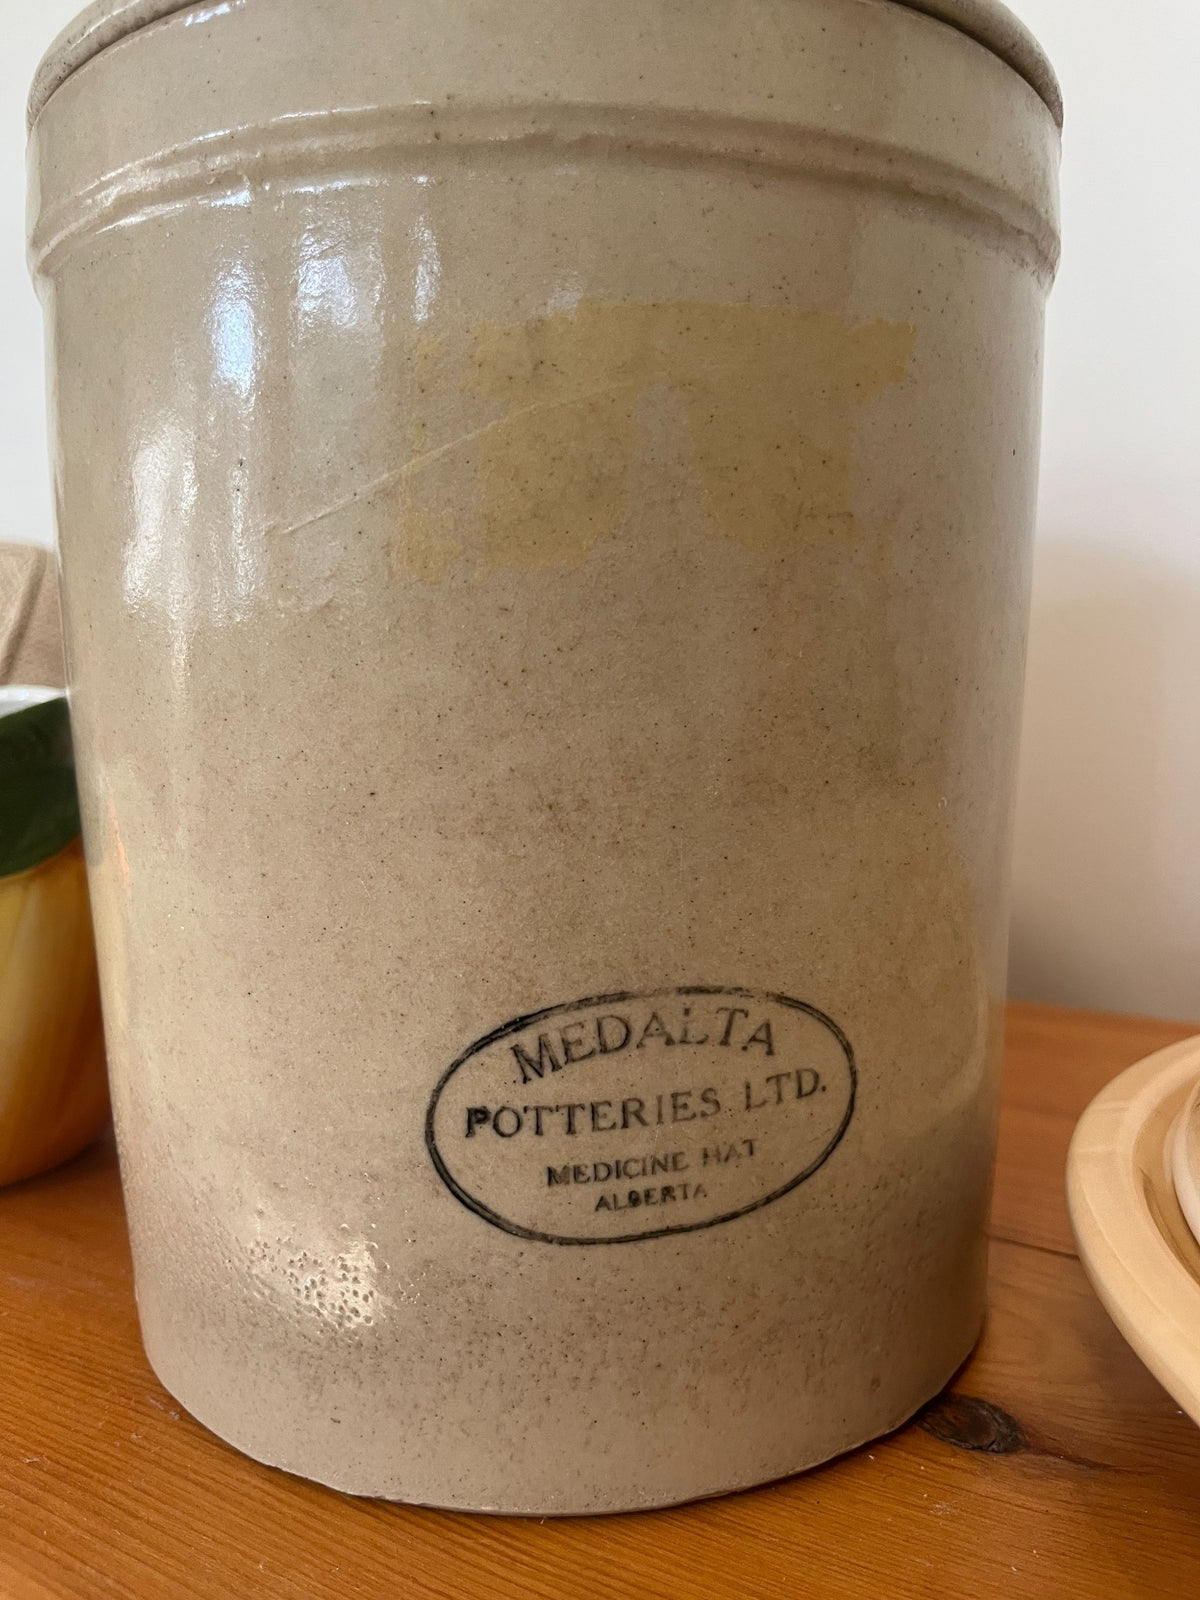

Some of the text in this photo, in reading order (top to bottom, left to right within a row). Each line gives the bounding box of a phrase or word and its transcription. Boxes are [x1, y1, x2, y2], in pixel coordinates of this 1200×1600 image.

[510, 1007, 776, 1084] MEDALTA
[465, 1068, 828, 1138] POTTERIES LTD.
[546, 1138, 757, 1187] MEDICINE HAT
[594, 1183, 708, 1212] ALBERTA
